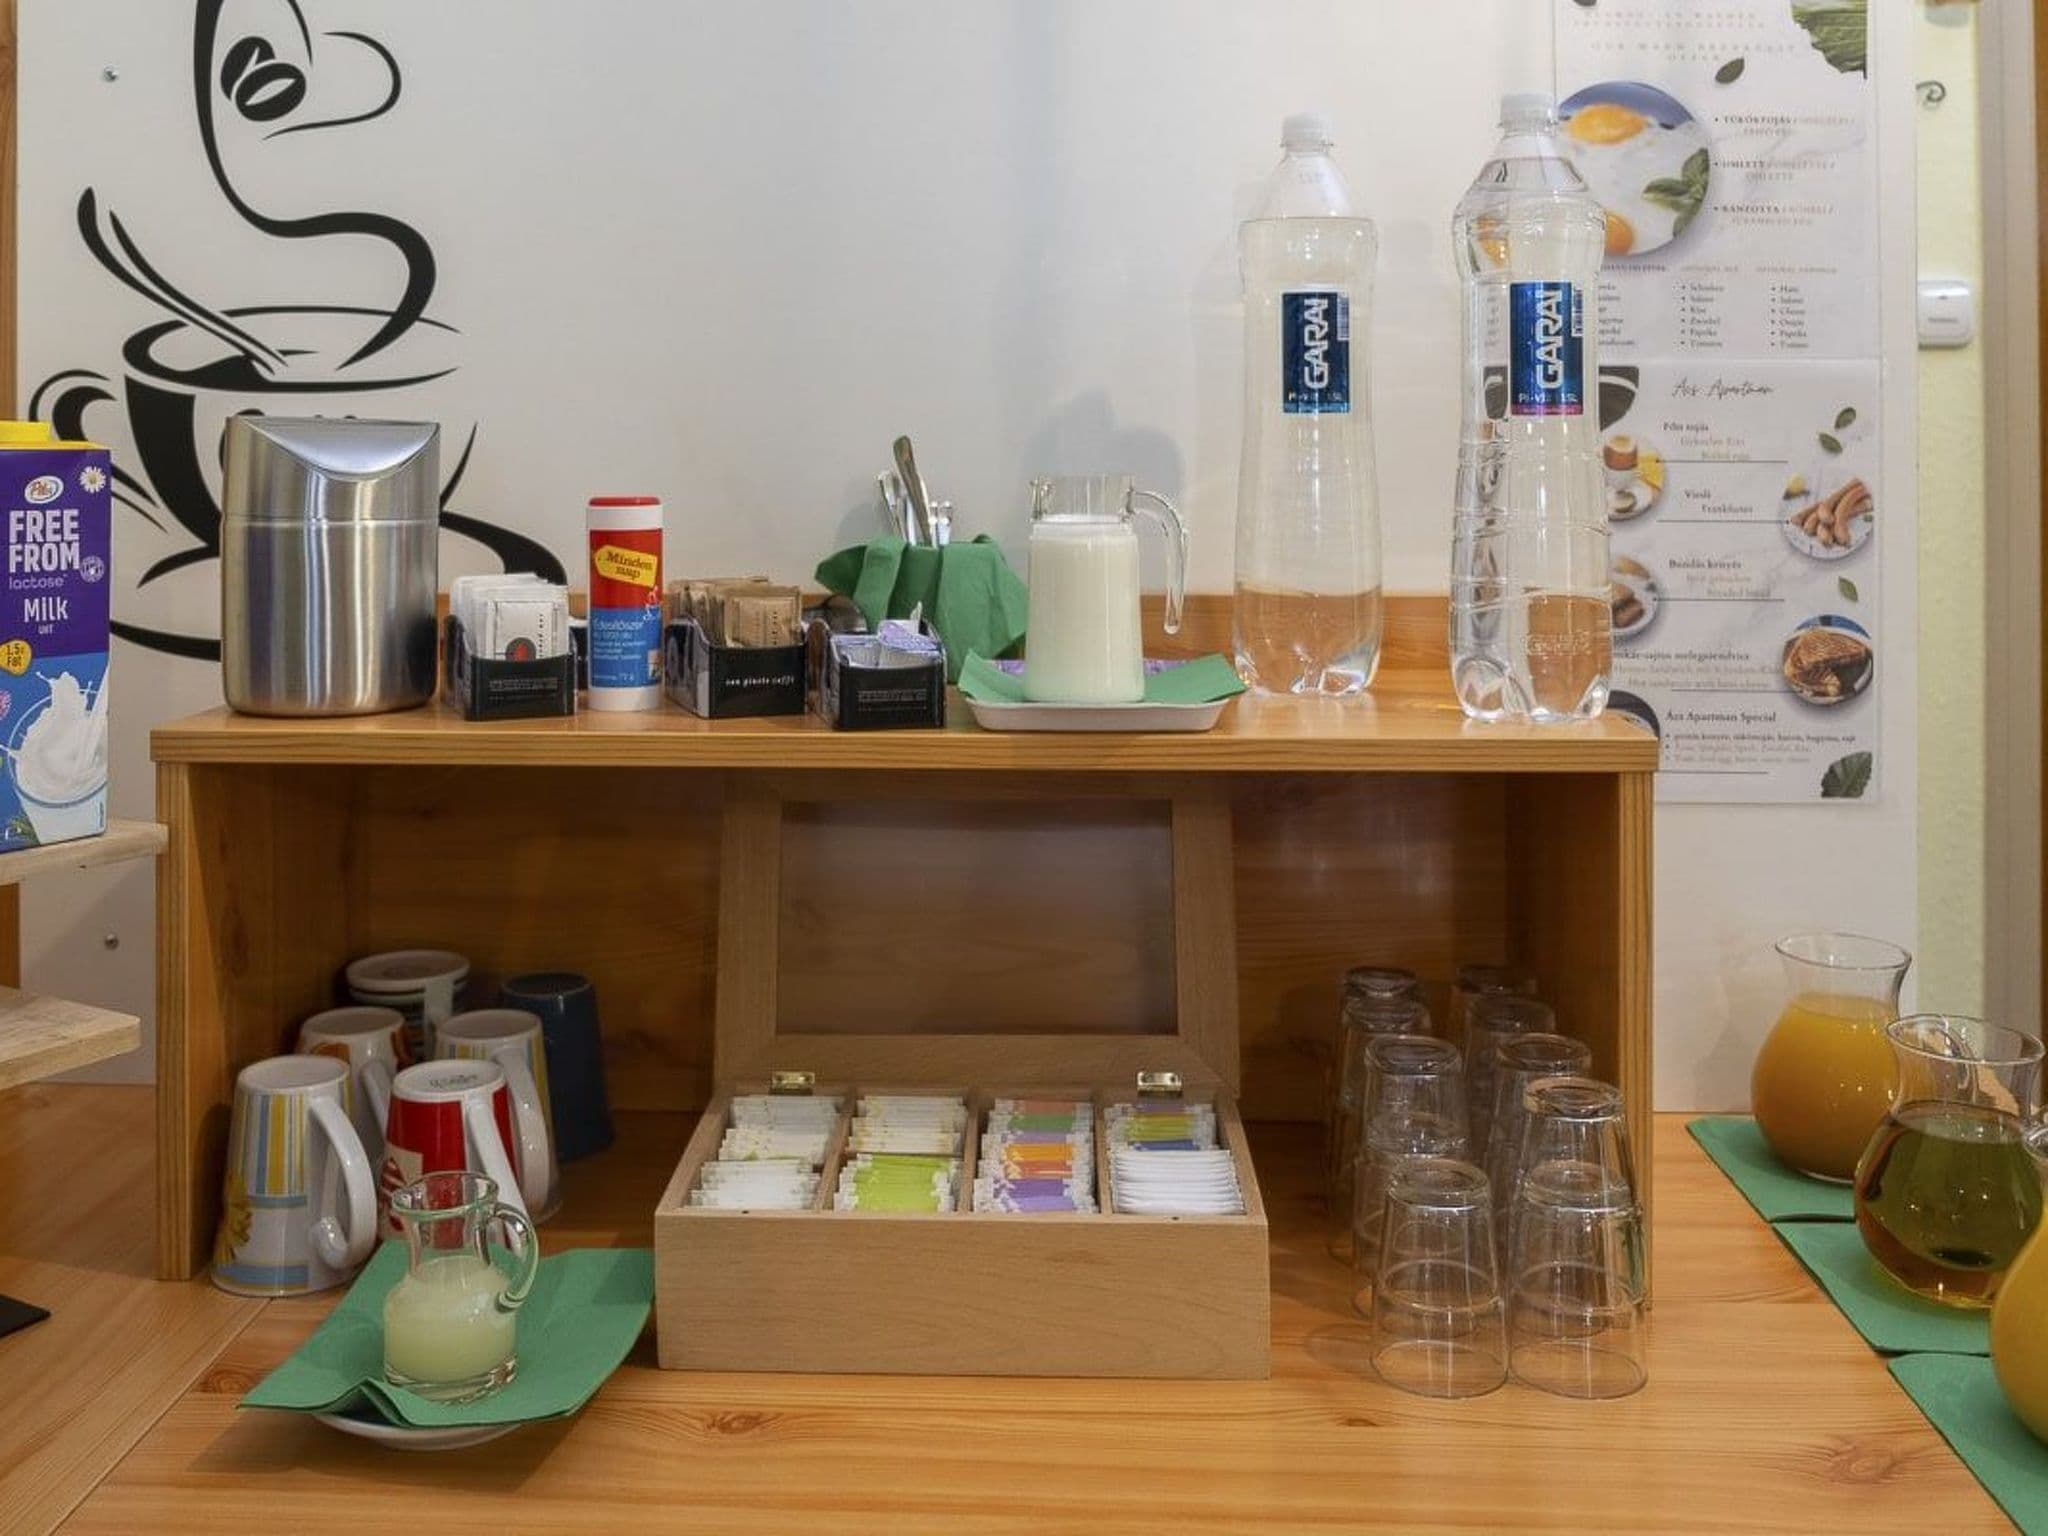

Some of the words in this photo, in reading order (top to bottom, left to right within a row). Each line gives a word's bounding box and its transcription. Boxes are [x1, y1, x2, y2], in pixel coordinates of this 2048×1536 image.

[1303, 298, 1329, 389] GARAI
[1534, 289, 1565, 389] GARAI
[9, 508, 80, 543] FREE
[9, 542, 80, 573] FROM
[607, 550, 653, 570] Minden
[8, 576, 65, 591] lactose
[616, 565, 641, 580] nap
[1741, 709, 1777, 724] Special
